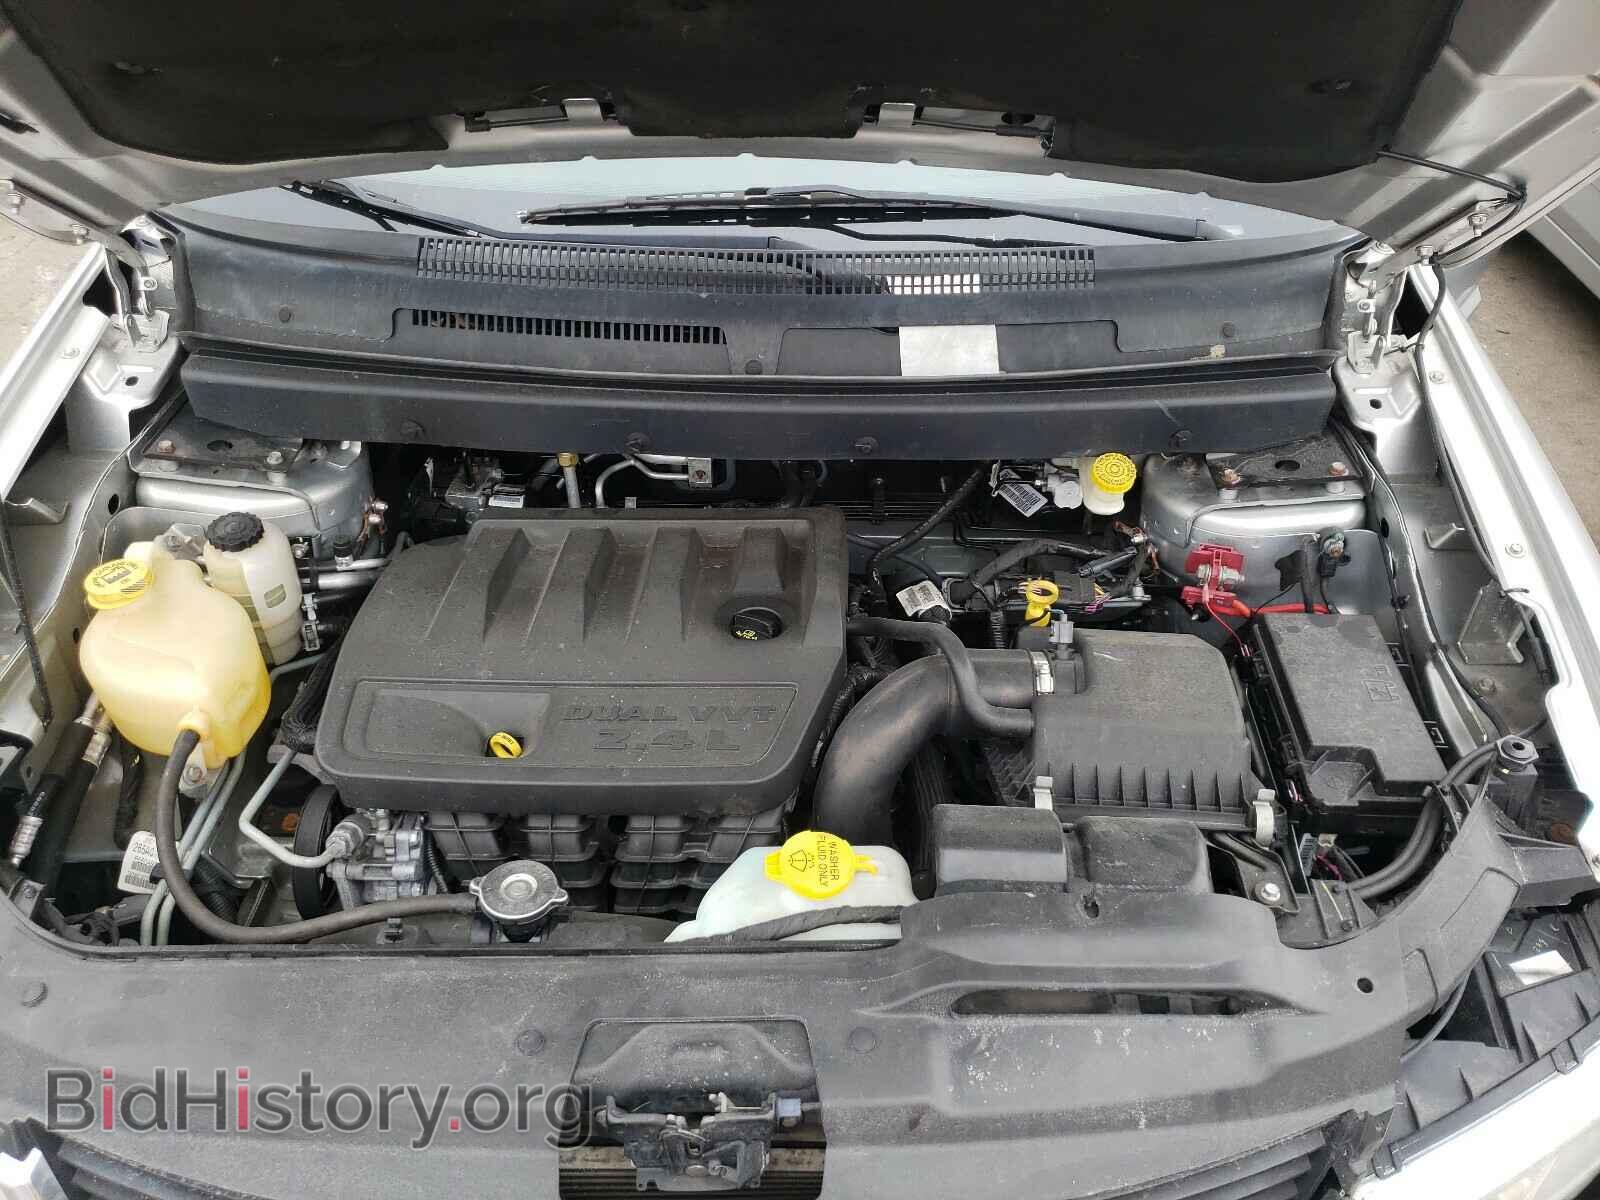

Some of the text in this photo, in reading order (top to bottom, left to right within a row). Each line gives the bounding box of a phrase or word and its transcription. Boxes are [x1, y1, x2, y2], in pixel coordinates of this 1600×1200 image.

[562, 703, 777, 723] DUAL VVT
[592, 729, 741, 752] 2.4L
[817, 835, 829, 888] FLUID ONLY
[829, 841, 840, 881] WASHER
